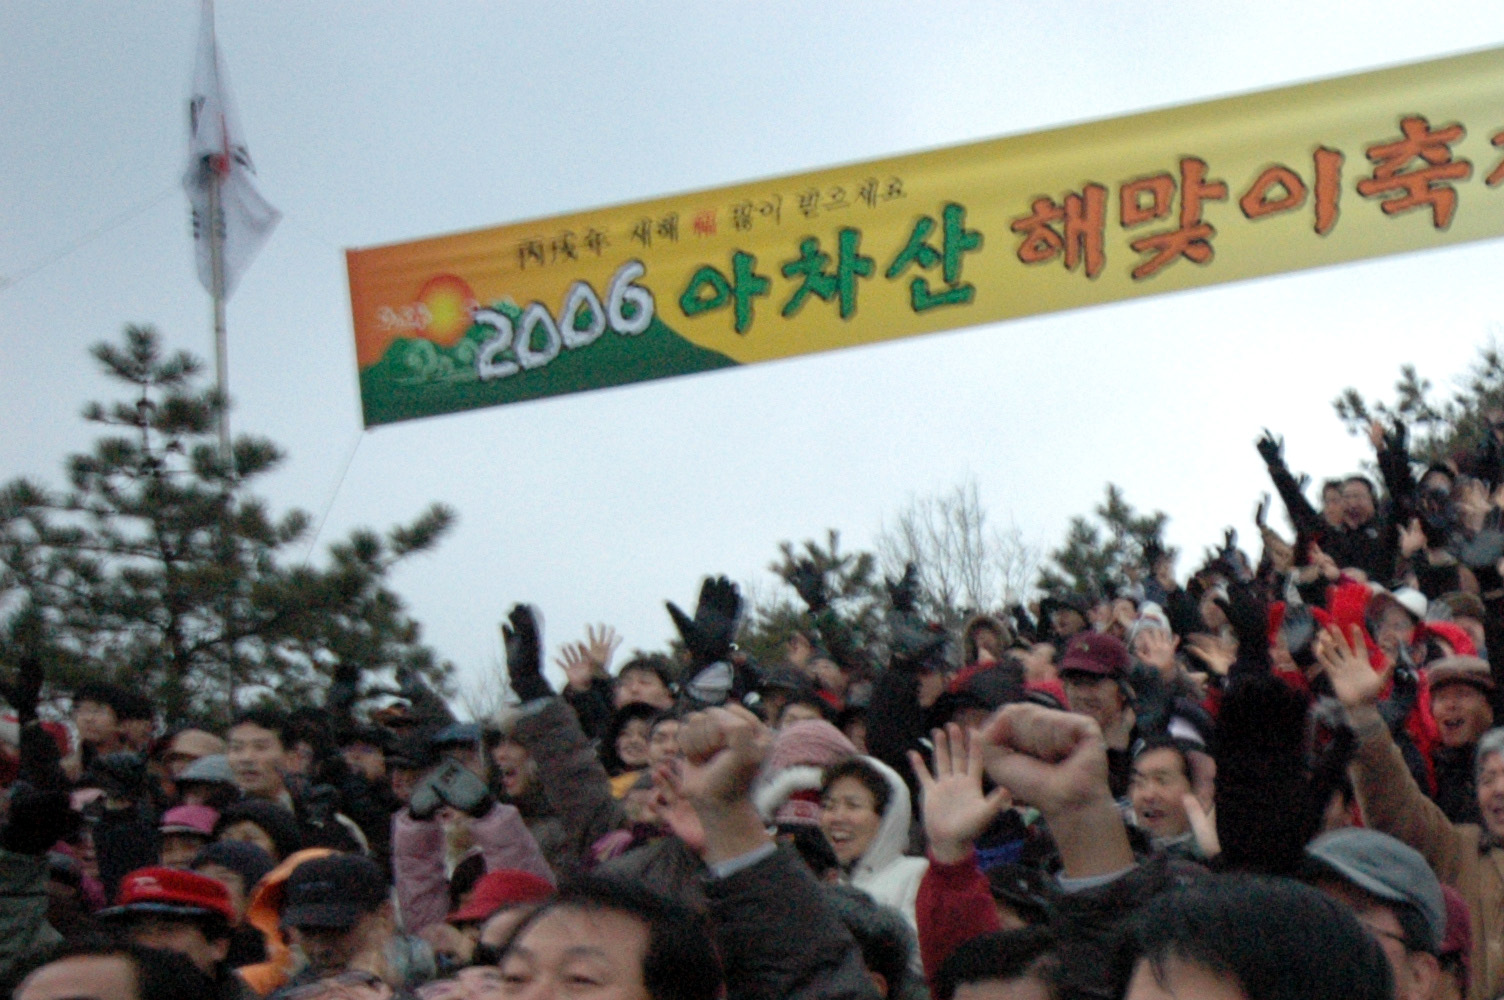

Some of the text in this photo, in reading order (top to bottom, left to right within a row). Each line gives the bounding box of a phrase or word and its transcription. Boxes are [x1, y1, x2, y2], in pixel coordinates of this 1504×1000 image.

[631, 213, 679, 249] 새해
[474, 259, 655, 381] 2006
[679, 202, 983, 333] 아차산
